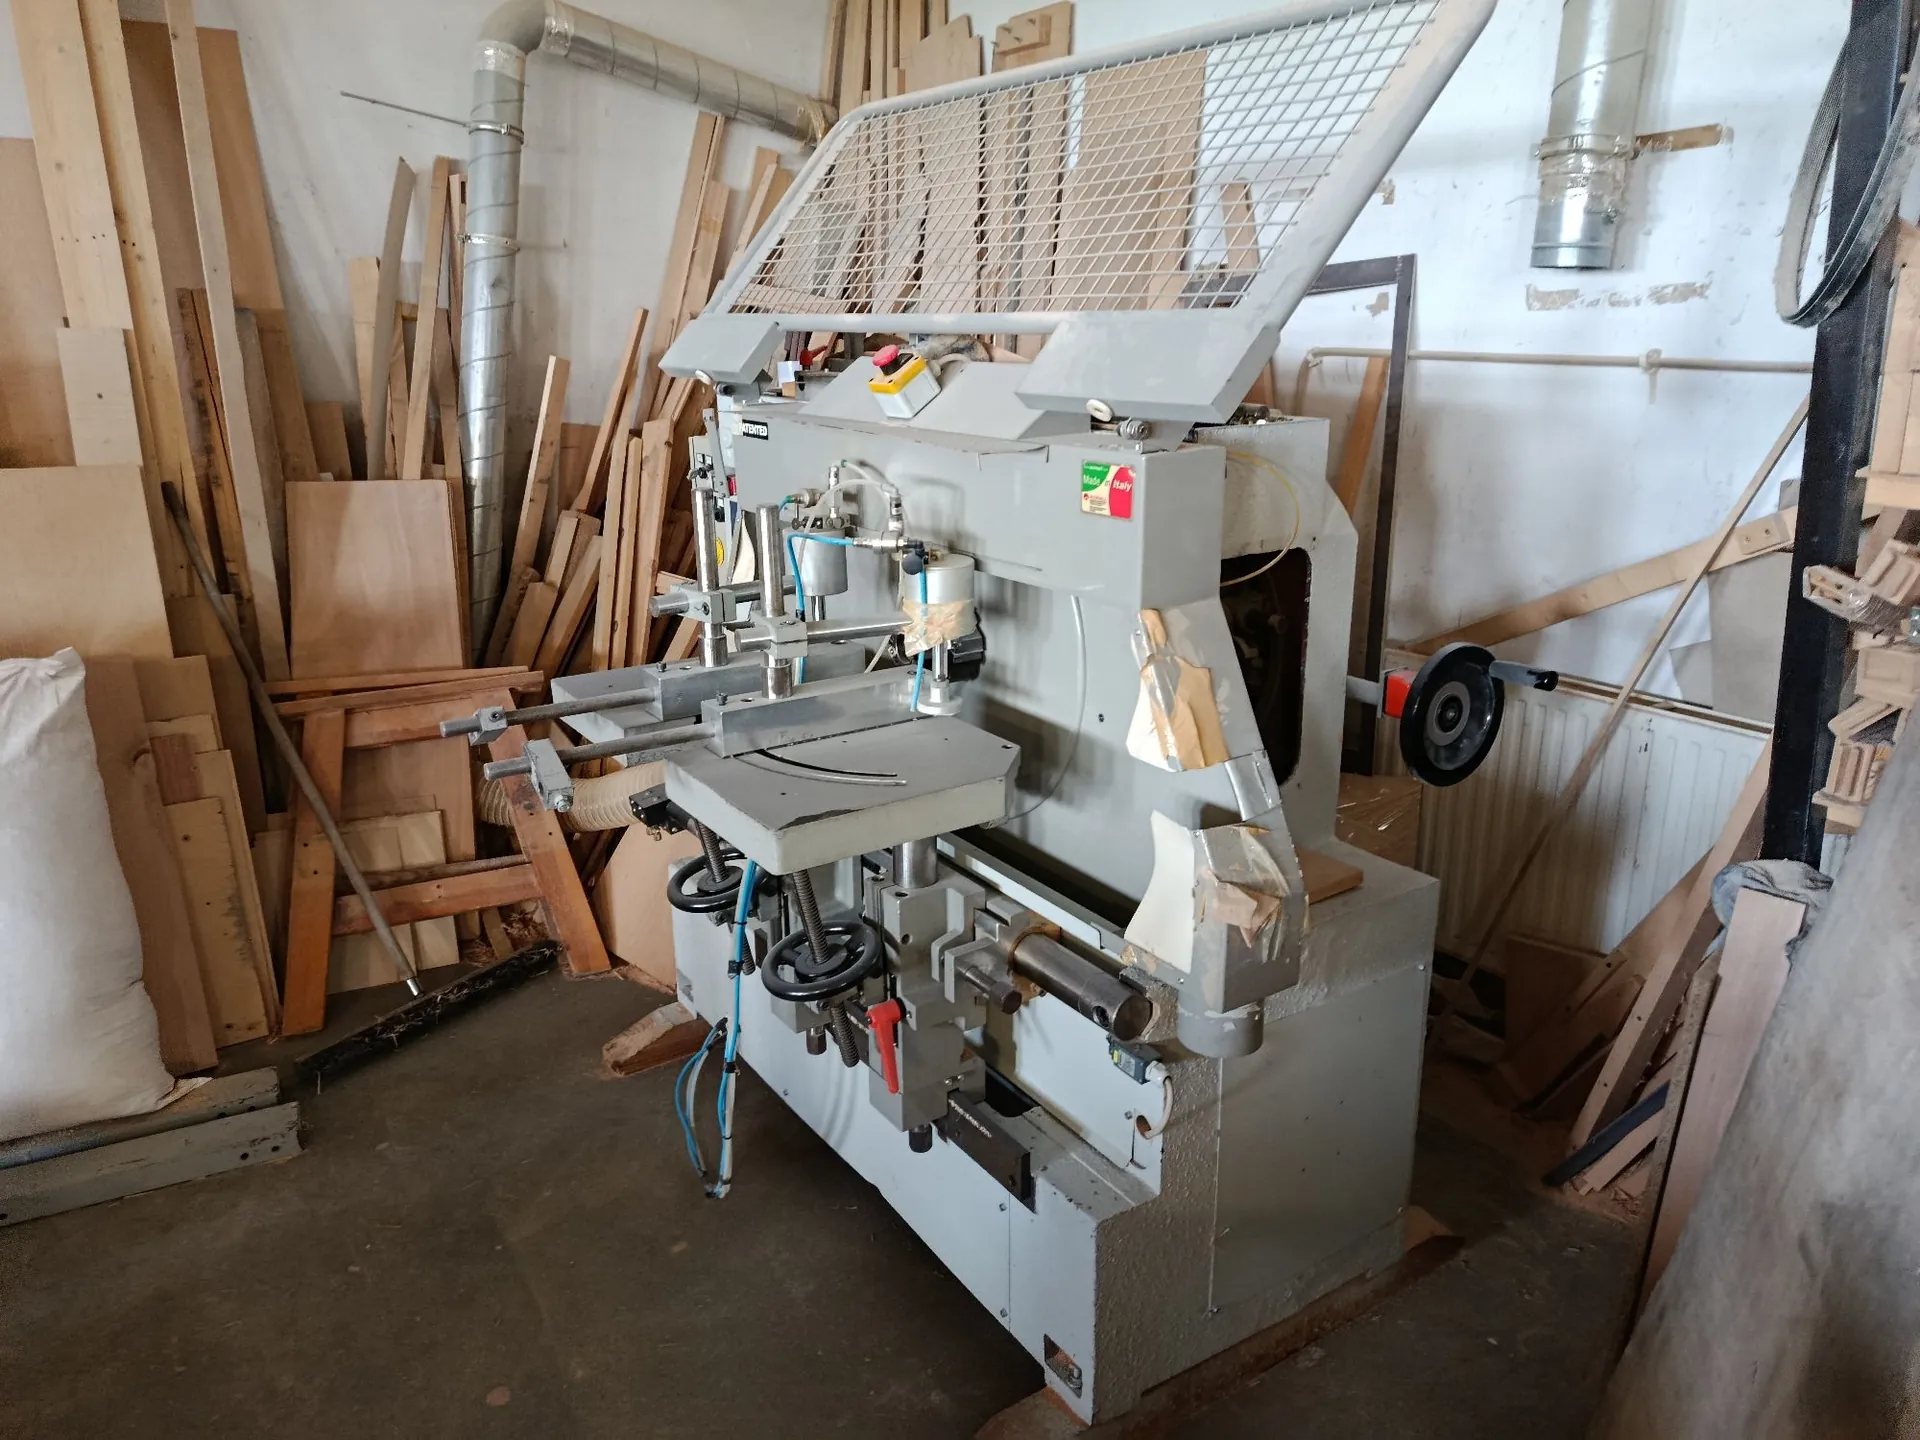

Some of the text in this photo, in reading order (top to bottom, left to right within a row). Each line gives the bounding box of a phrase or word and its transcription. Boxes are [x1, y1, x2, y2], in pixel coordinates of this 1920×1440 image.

[741, 422, 767, 436] ATENTED
[1083, 474, 1100, 486] Made
[1113, 480, 1132, 492] Italy
